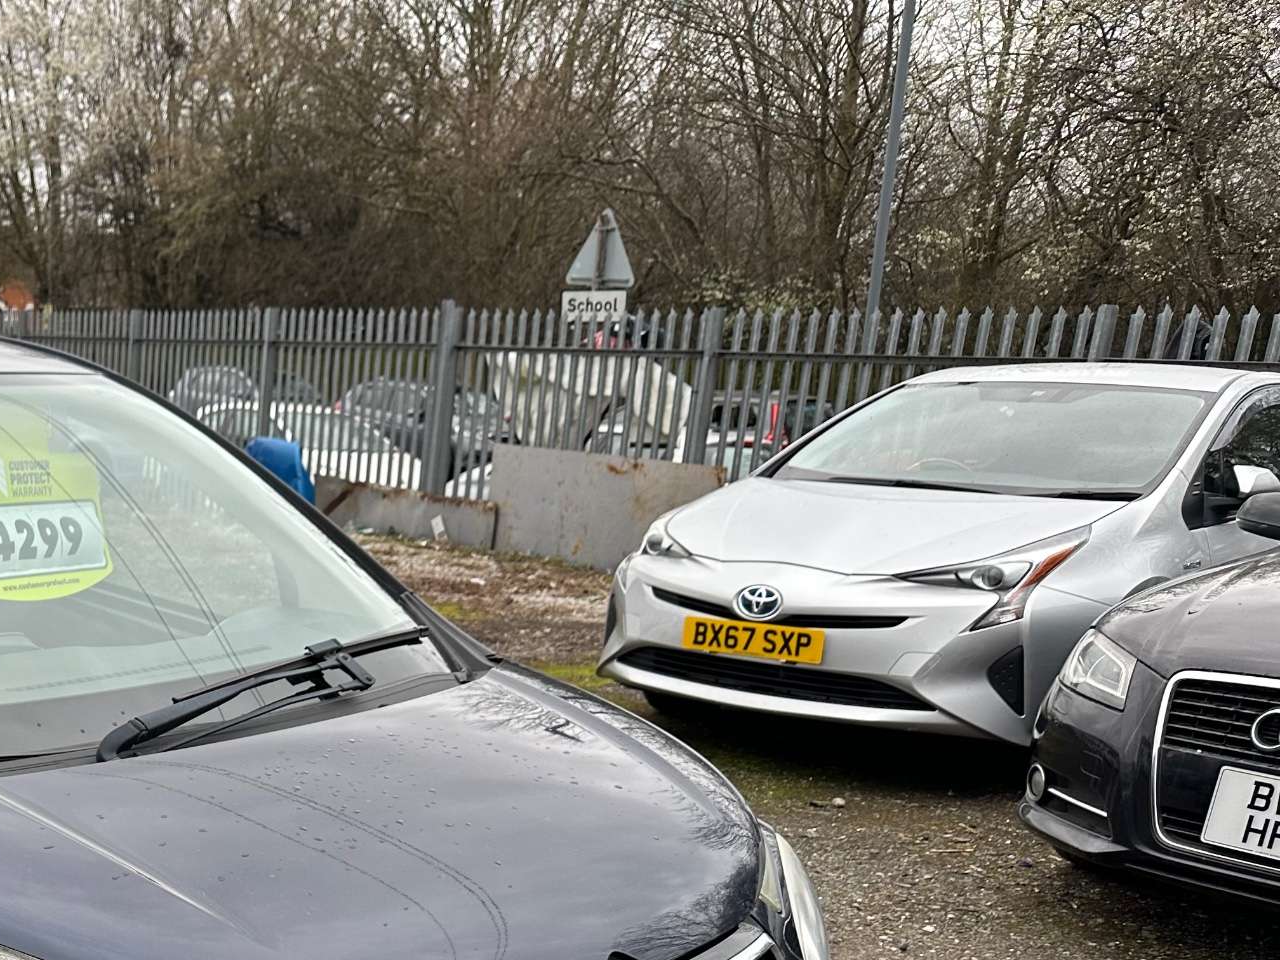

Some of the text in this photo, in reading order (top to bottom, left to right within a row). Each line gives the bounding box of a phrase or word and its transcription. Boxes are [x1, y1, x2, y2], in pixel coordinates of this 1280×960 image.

[567, 297, 618, 313] School
[9, 460, 50, 471] CUSTOMER
[10, 472, 51, 485] PROTECT
[12, 486, 52, 497] WARRANTY
[693, 622, 812, 657] BX67 SXP
[1247, 780, 1280, 815] B
